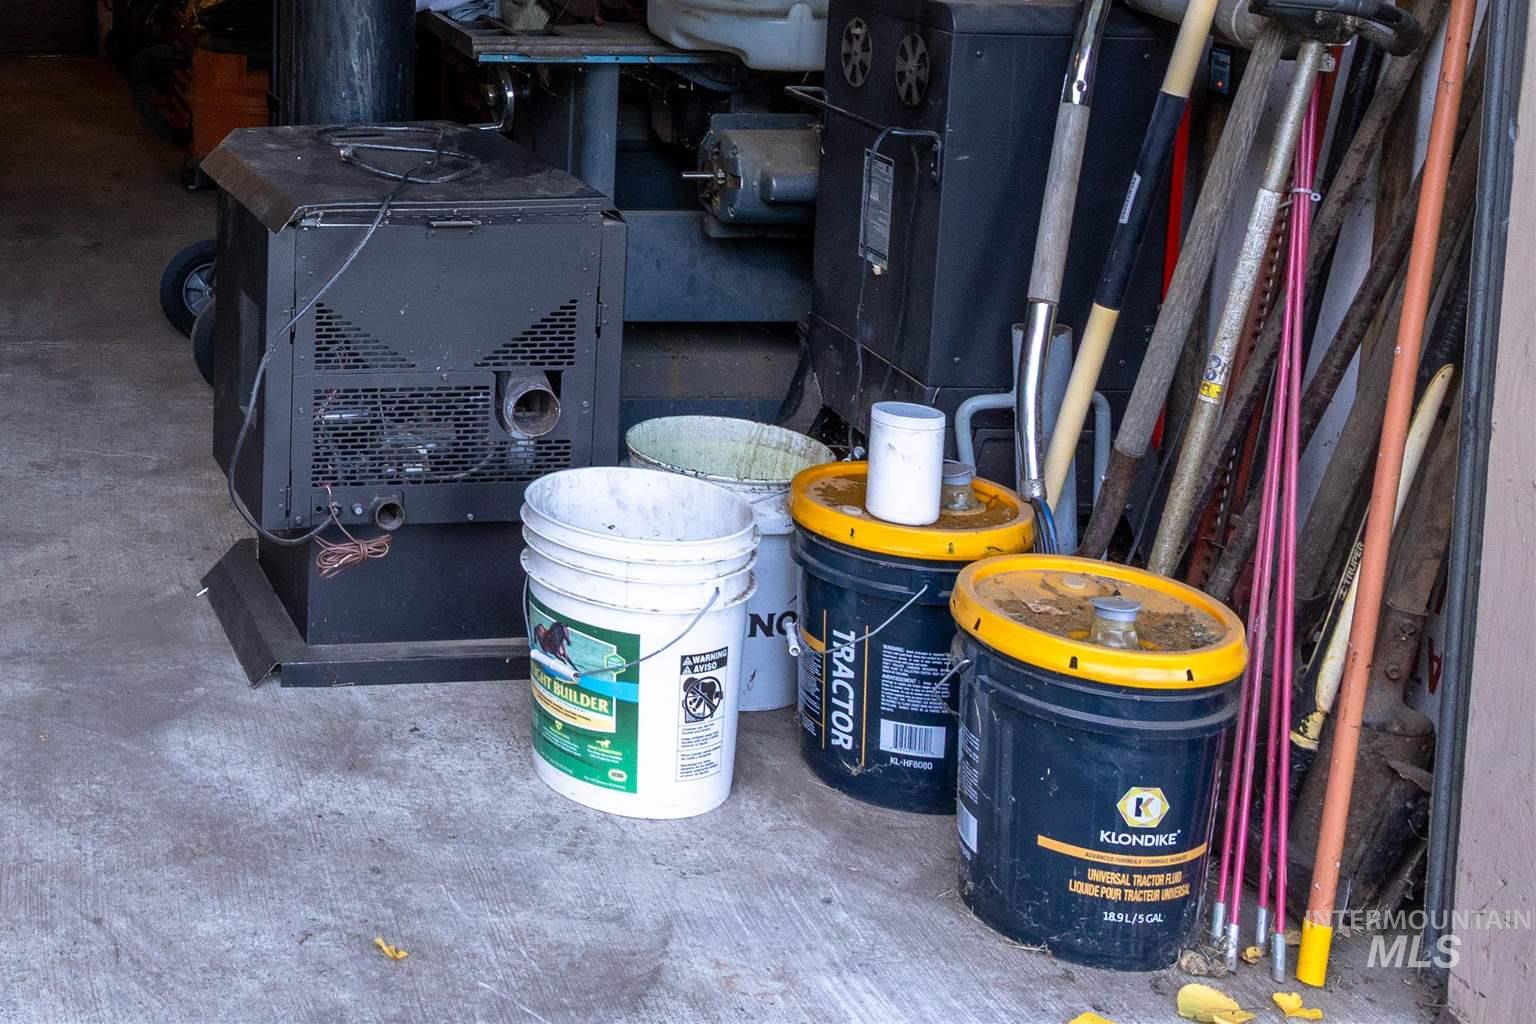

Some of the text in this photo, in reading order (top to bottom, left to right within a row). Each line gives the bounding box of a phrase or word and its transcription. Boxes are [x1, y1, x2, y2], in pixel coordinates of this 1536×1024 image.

[1344, 541, 1364, 587] TRUPER
[692, 649, 727, 664] WARNING
[693, 661, 717, 673] AVISO
[554, 680, 608, 714] BUILDER
[831, 628, 856, 750] TRACTOR
[1100, 830, 1177, 846] KLONDIKE
[1088, 868, 1182, 886] UNIVERSAL TRACTOR FLUID
[1068, 880, 1100, 898] LIQUIDE
[1101, 886, 1122, 900] POUR
[1124, 888, 1160, 902] TRACTEUR
[1146, 913, 1164, 923] GAL
